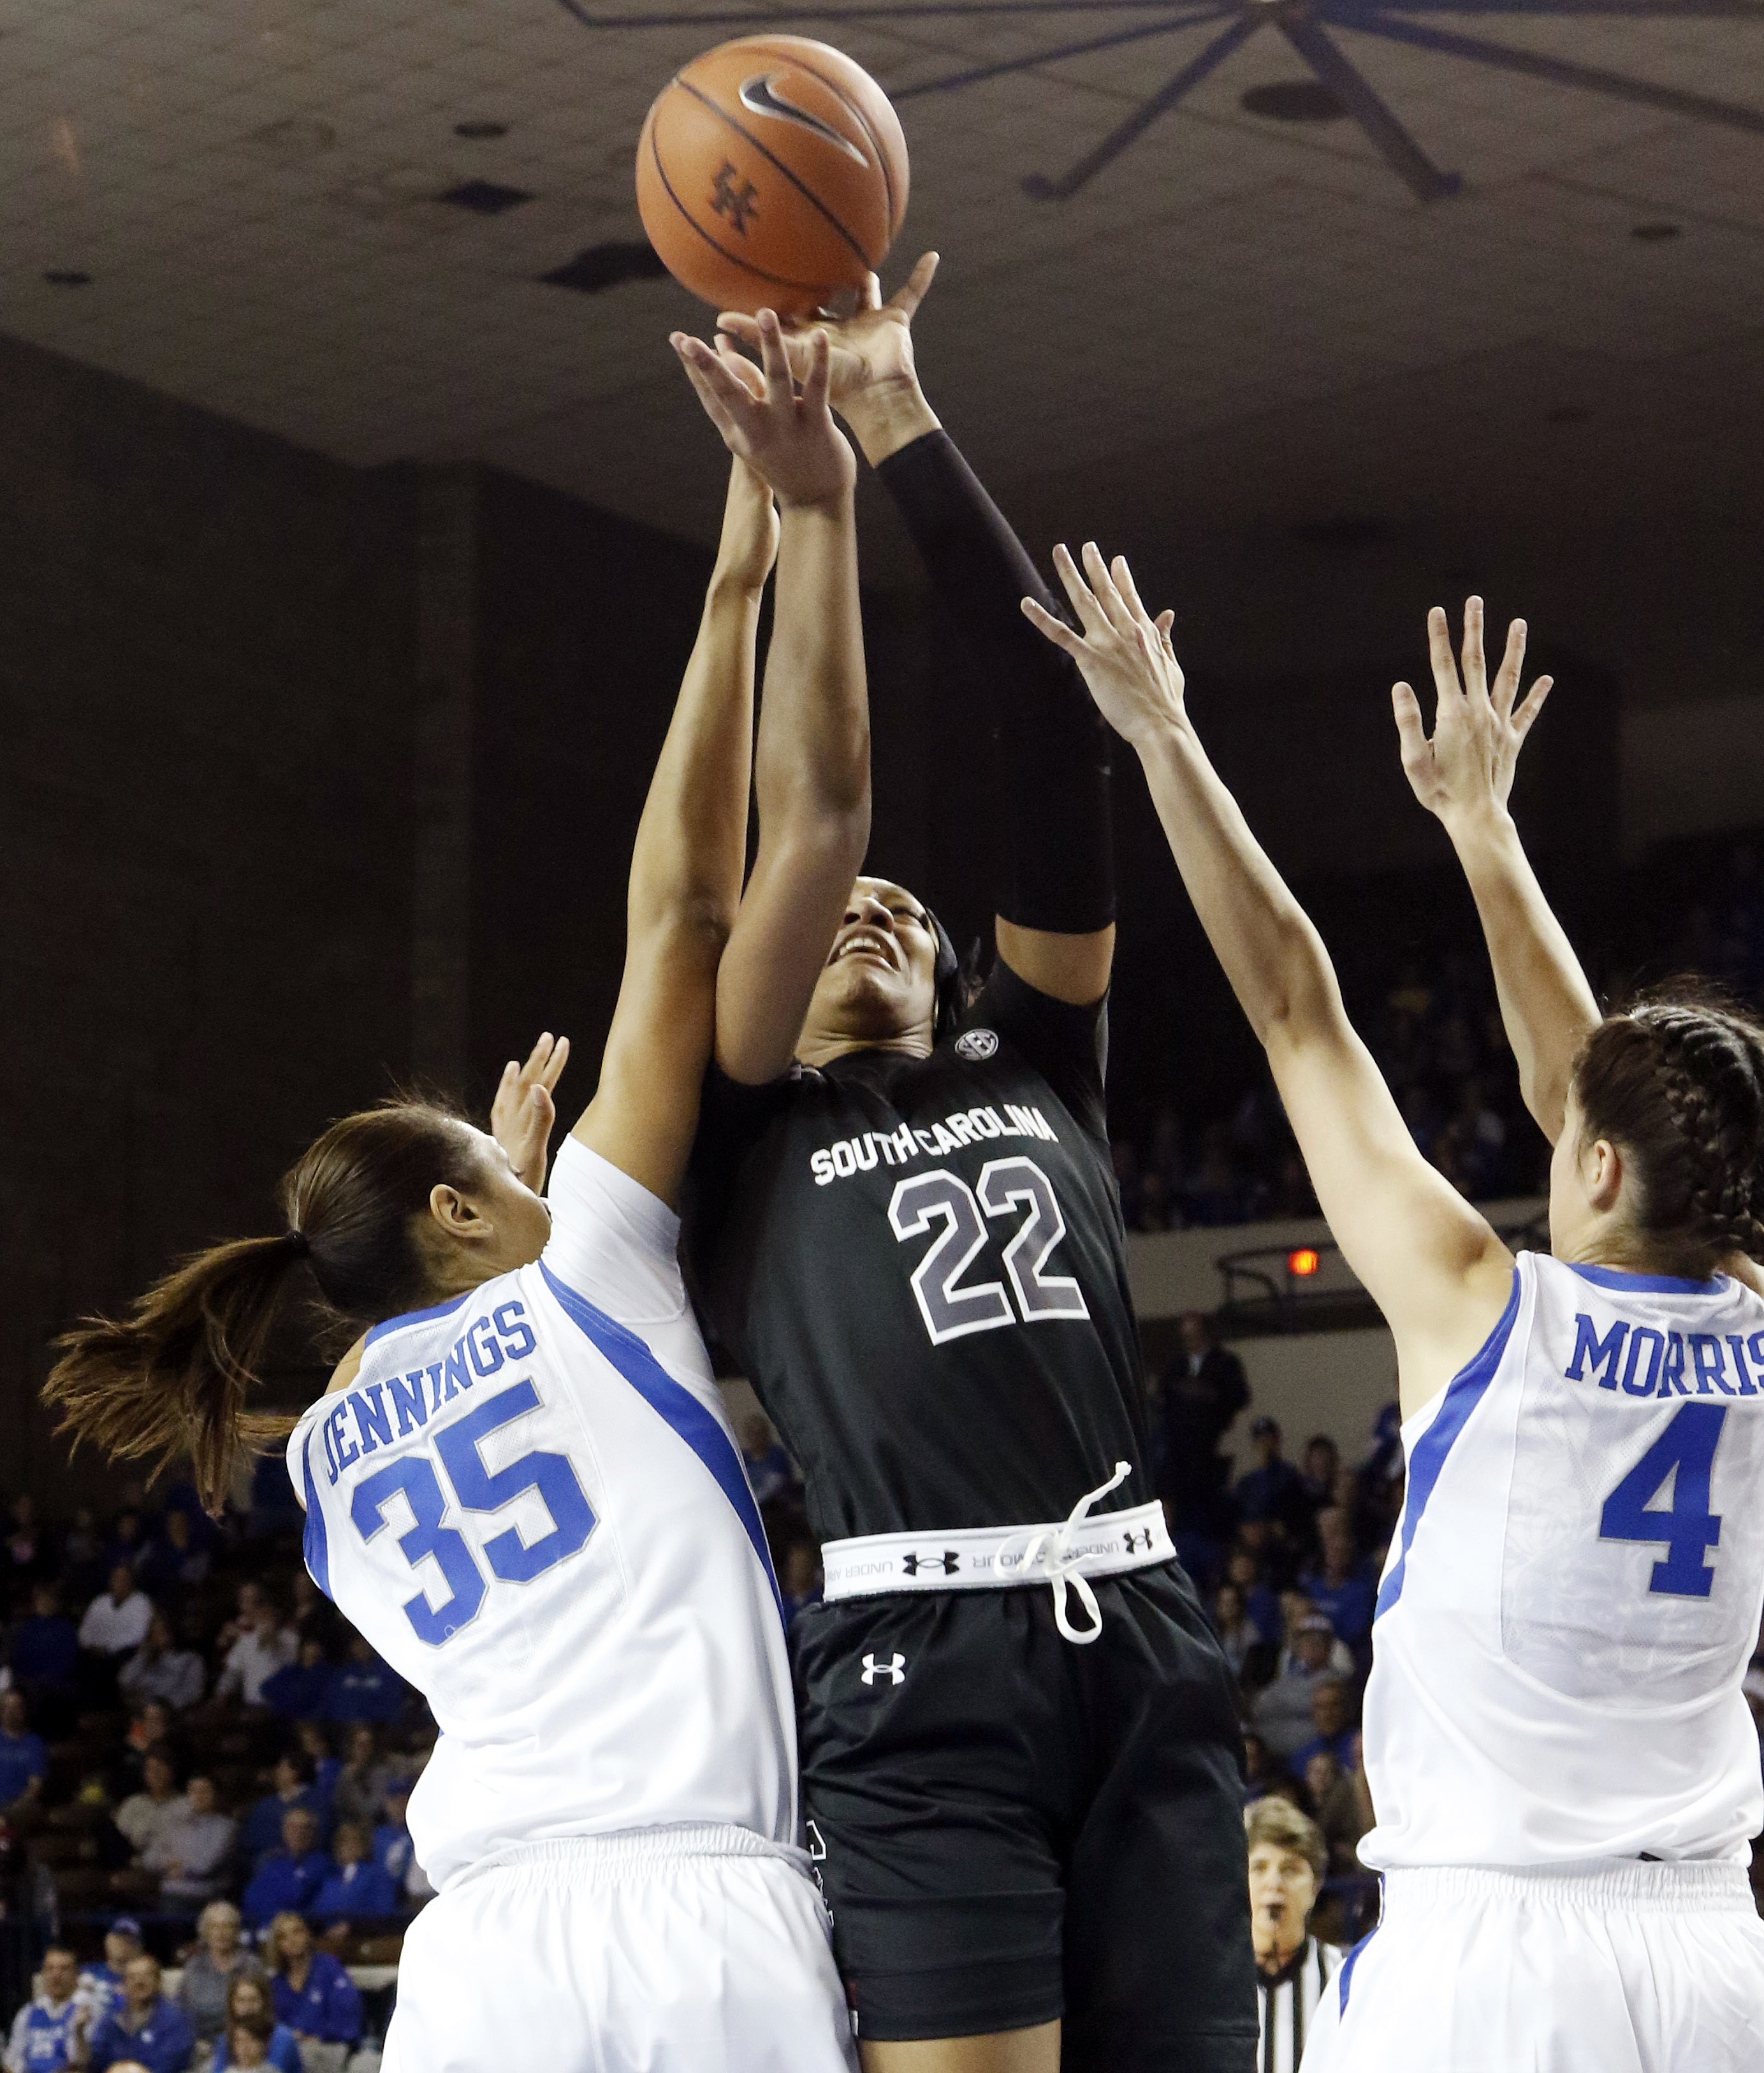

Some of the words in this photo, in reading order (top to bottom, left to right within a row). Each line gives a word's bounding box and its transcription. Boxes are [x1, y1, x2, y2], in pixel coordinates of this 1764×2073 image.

[810, 1122, 919, 1186] SOUTH
[912, 1103, 1059, 1156] CAROLINA
[887, 1156, 1090, 1346] 22
[323, 1300, 536, 1486] JENNINGS
[349, 1375, 601, 1650] 35
[845, 1560, 893, 1579] UNDER
[1598, 1400, 1728, 1601] 4
